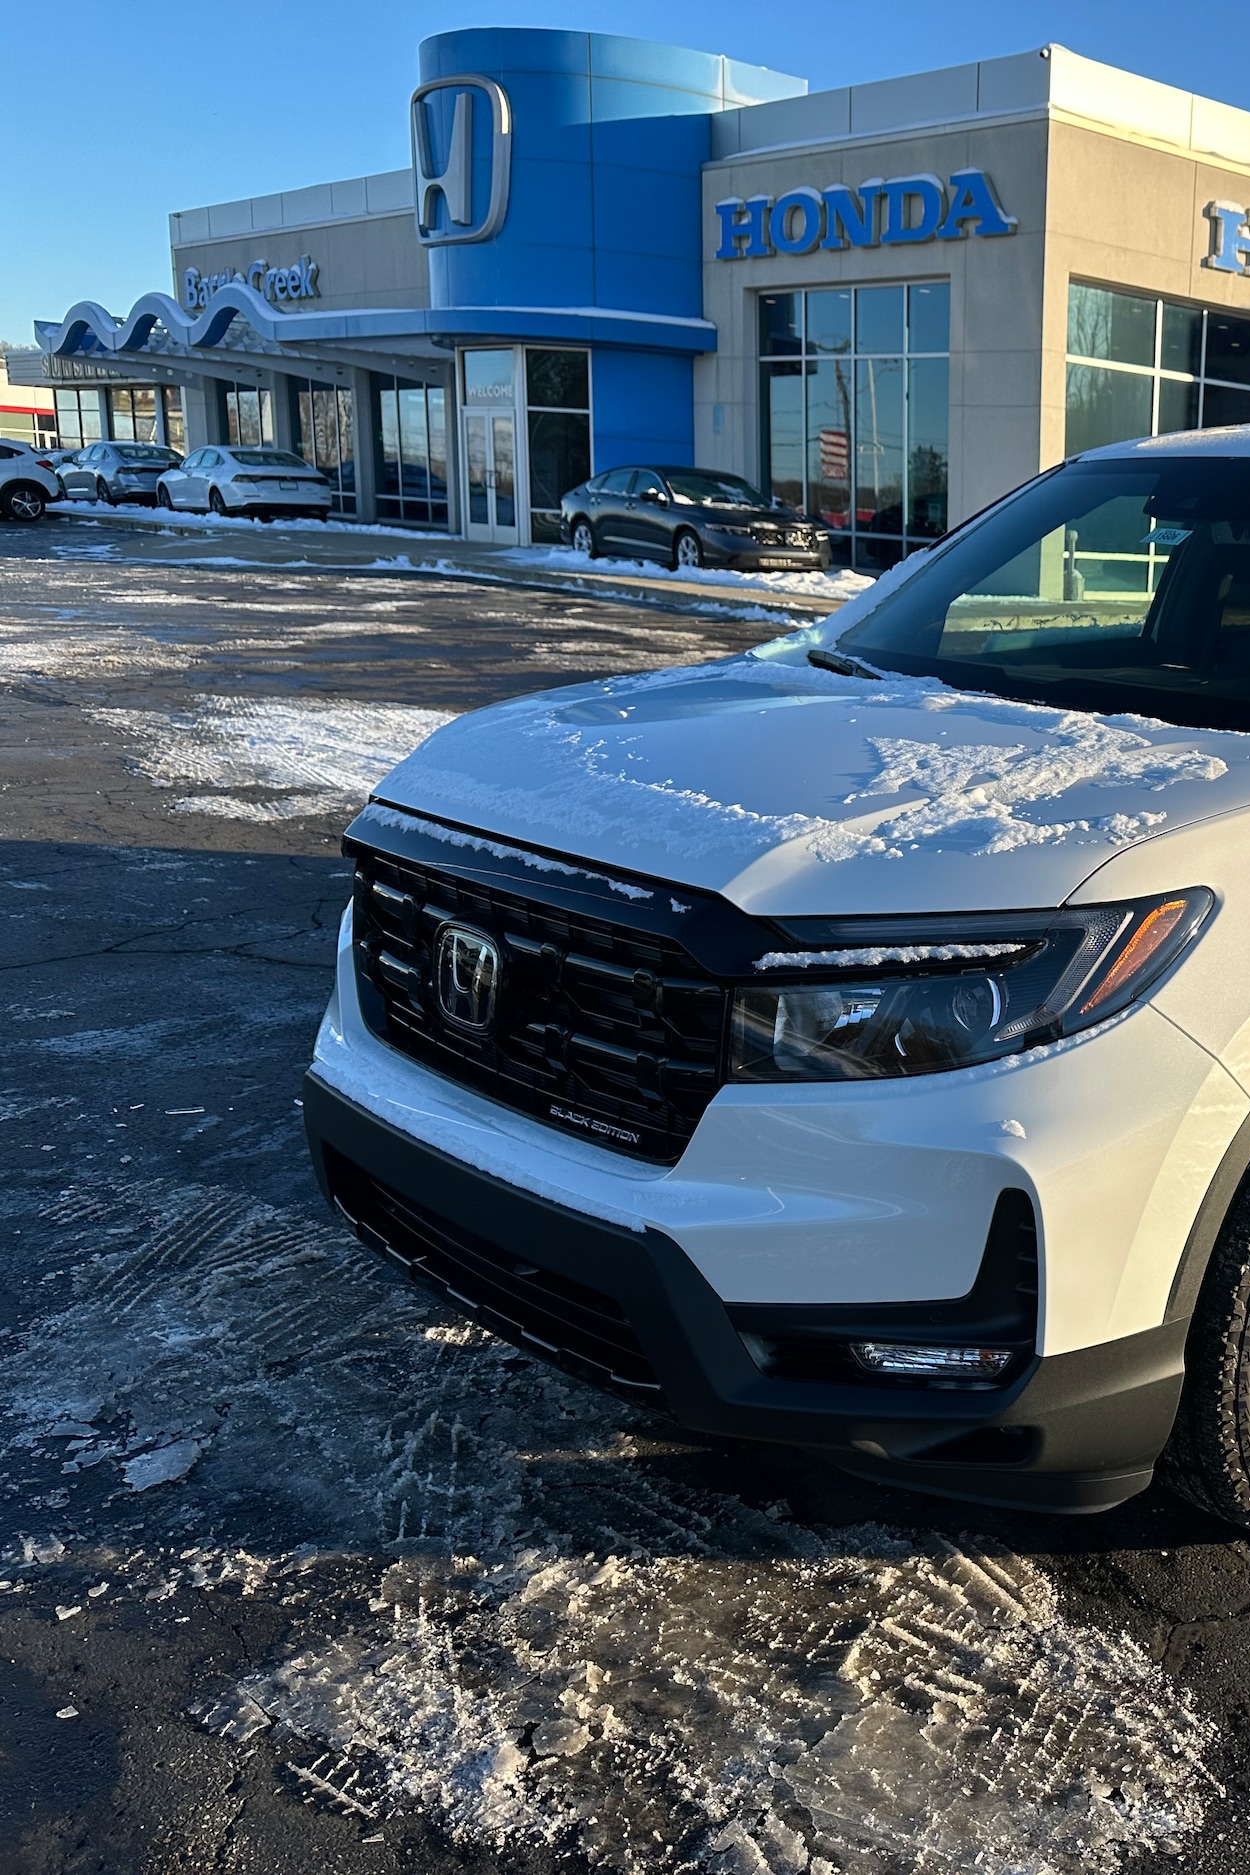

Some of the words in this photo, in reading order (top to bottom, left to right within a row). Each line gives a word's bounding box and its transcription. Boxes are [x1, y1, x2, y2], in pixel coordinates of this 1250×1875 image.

[715, 167, 1018, 260] HONDA
[247, 254, 319, 301] Creek
[469, 385, 513, 398] WELCOME
[549, 1104, 591, 1128] BLACK
[590, 1119, 641, 1144] EDITION
